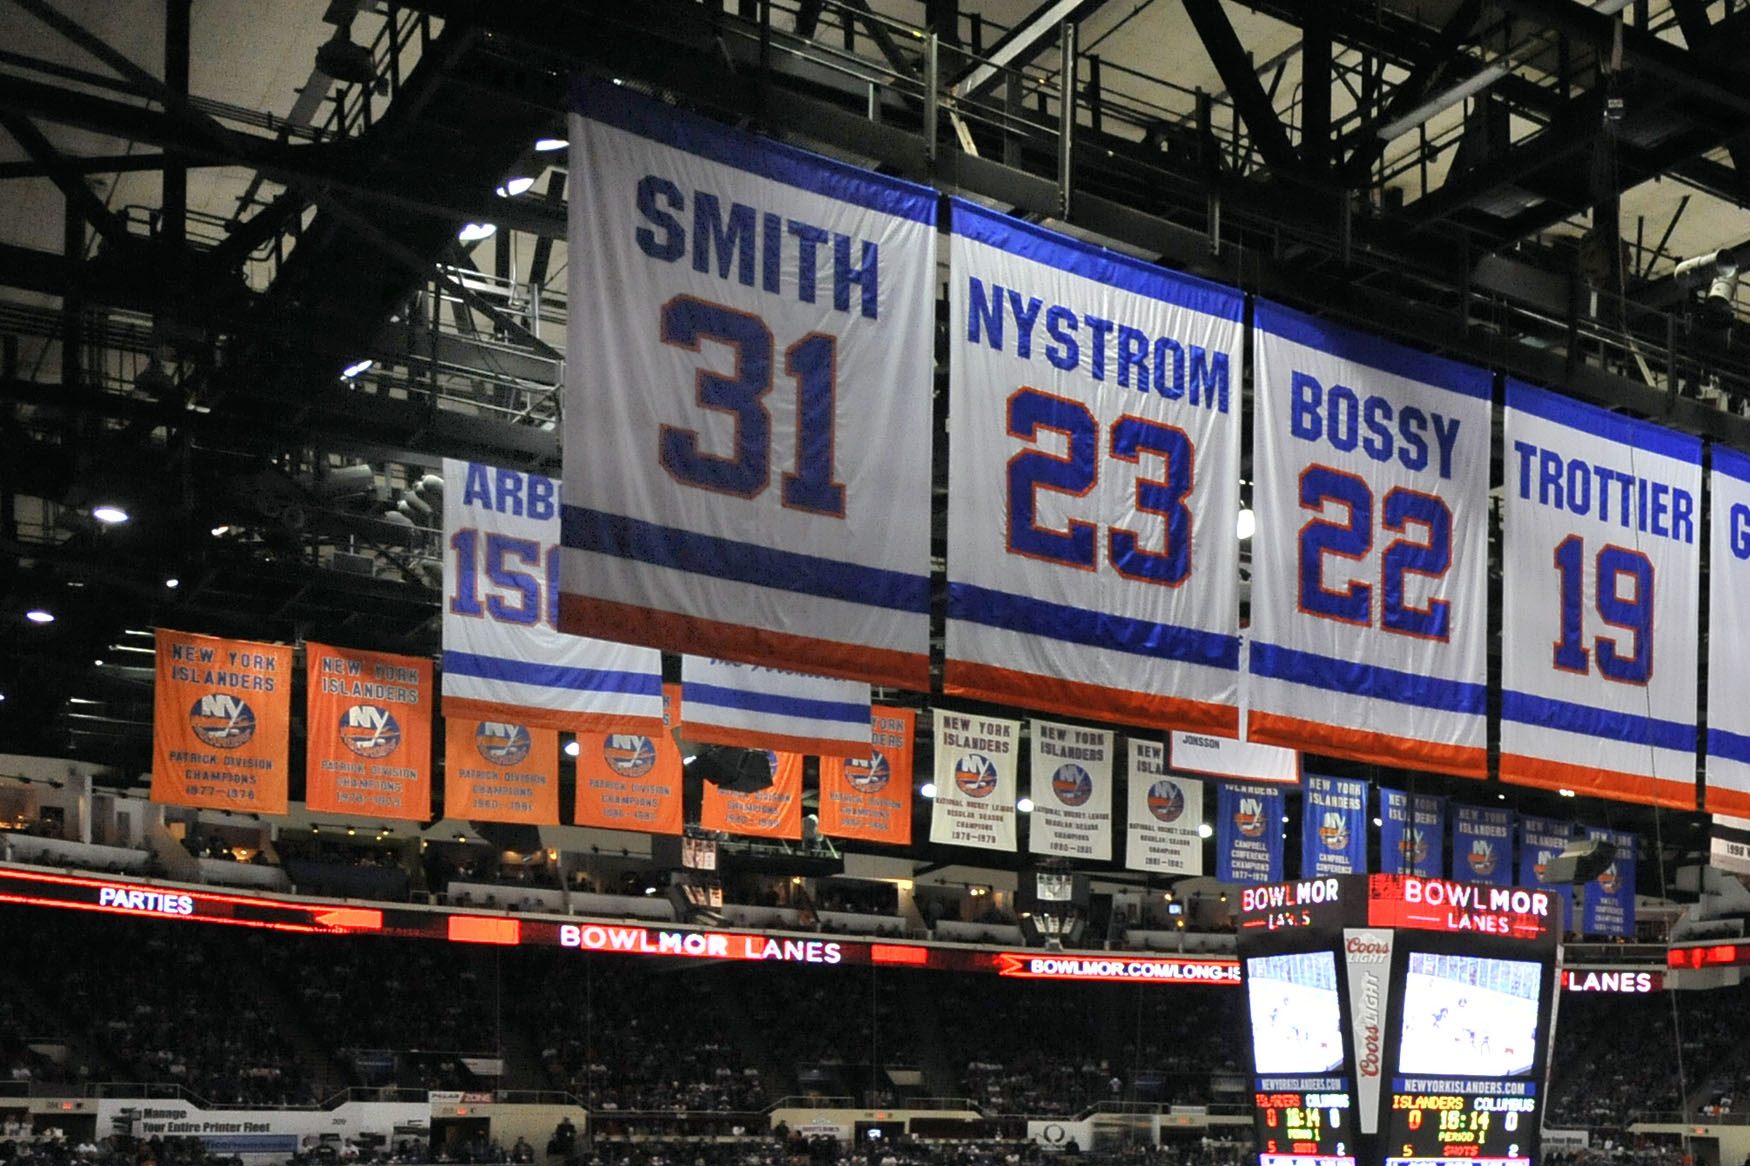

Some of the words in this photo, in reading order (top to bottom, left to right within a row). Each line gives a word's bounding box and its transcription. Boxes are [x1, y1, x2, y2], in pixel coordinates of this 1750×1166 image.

[634, 175, 879, 319] SMITH
[967, 277, 1229, 413] NYSTROM
[657, 294, 846, 519] 31
[1290, 371, 1460, 480] BOSSY
[463, 463, 562, 521] ARB
[1005, 386, 1194, 588] 23
[1514, 441, 1694, 544] TROTTIER
[1297, 463, 1453, 643] 22
[1552, 534, 1654, 686] 19
[172, 643, 214, 663] NEW
[228, 652, 276, 671] YORK
[172, 666, 276, 692] ISLANDERS
[322, 657, 361, 677] NEW
[375, 664, 419, 684] YORK
[322, 678, 418, 703] ISLANDERS
[943, 715, 970, 731] NEW
[979, 721, 1011, 738] YORK
[1040, 725, 1067, 740] NEW
[1075, 731, 1104, 746] YORK
[943, 732, 1010, 754] ISLANDERS
[1040, 742, 1104, 761] ISLANDERS
[1137, 744, 1161, 759] NEW
[1182, 735, 1220, 750] JONSSON
[170, 751, 217, 765] PATRICK
[223, 756, 272, 769] DIVISION
[185, 770, 256, 784] CHAMPIONS
[1309, 777, 1330, 790] NEW
[1337, 782, 1361, 796] YORK
[1309, 793, 1361, 810] ISLANDERS
[1459, 809, 1478, 821] NEW
[1459, 823, 1507, 837] ISLANDERS
[1526, 834, 1569, 849] ISLANDERS
[1231, 850, 1270, 861] CONFERENCE
[100, 887, 194, 915] PARTIES
[1243, 879, 1339, 911] BOWLMOR
[1405, 880, 1548, 916] BOWLMOR
[1448, 913, 1510, 933] LANES
[560, 925, 729, 958] BOWLMOR
[744, 939, 842, 964] LANES
[1346, 937, 1389, 955] Coors
[1348, 954, 1388, 965] LIGHT
[1569, 970, 1651, 992] LANES
[1364, 971, 1380, 1026] LIGHT
[1360, 1024, 1380, 1078] Coors
[1262, 1077, 1342, 1091] NEWYORKISLANDERS.COM
[1404, 1079, 1525, 1095] NEWYORKISLANDERS.COM
[143, 1108, 187, 1119] Manage
[1392, 1095, 1464, 1110] ISLANDERS
[1473, 1097, 1535, 1112] COLUMBUS
[142, 1122, 165, 1133] Your
[167, 1122, 200, 1133] Entire
[203, 1122, 242, 1133] Printer
[244, 1122, 270, 1133] Fleet
[1408, 1110, 1422, 1130] 0
[1505, 1111, 1518, 1131] 0
[1438, 1131, 1474, 1142] PERIOD
[1477, 1131, 1485, 1144] 1
[1267, 1141, 1276, 1153] 5
[1336, 1143, 1345, 1156] 2
[1402, 1144, 1413, 1157] 5
[1443, 1145, 1479, 1156] SHOTS
[1508, 1144, 1519, 1158] 2
